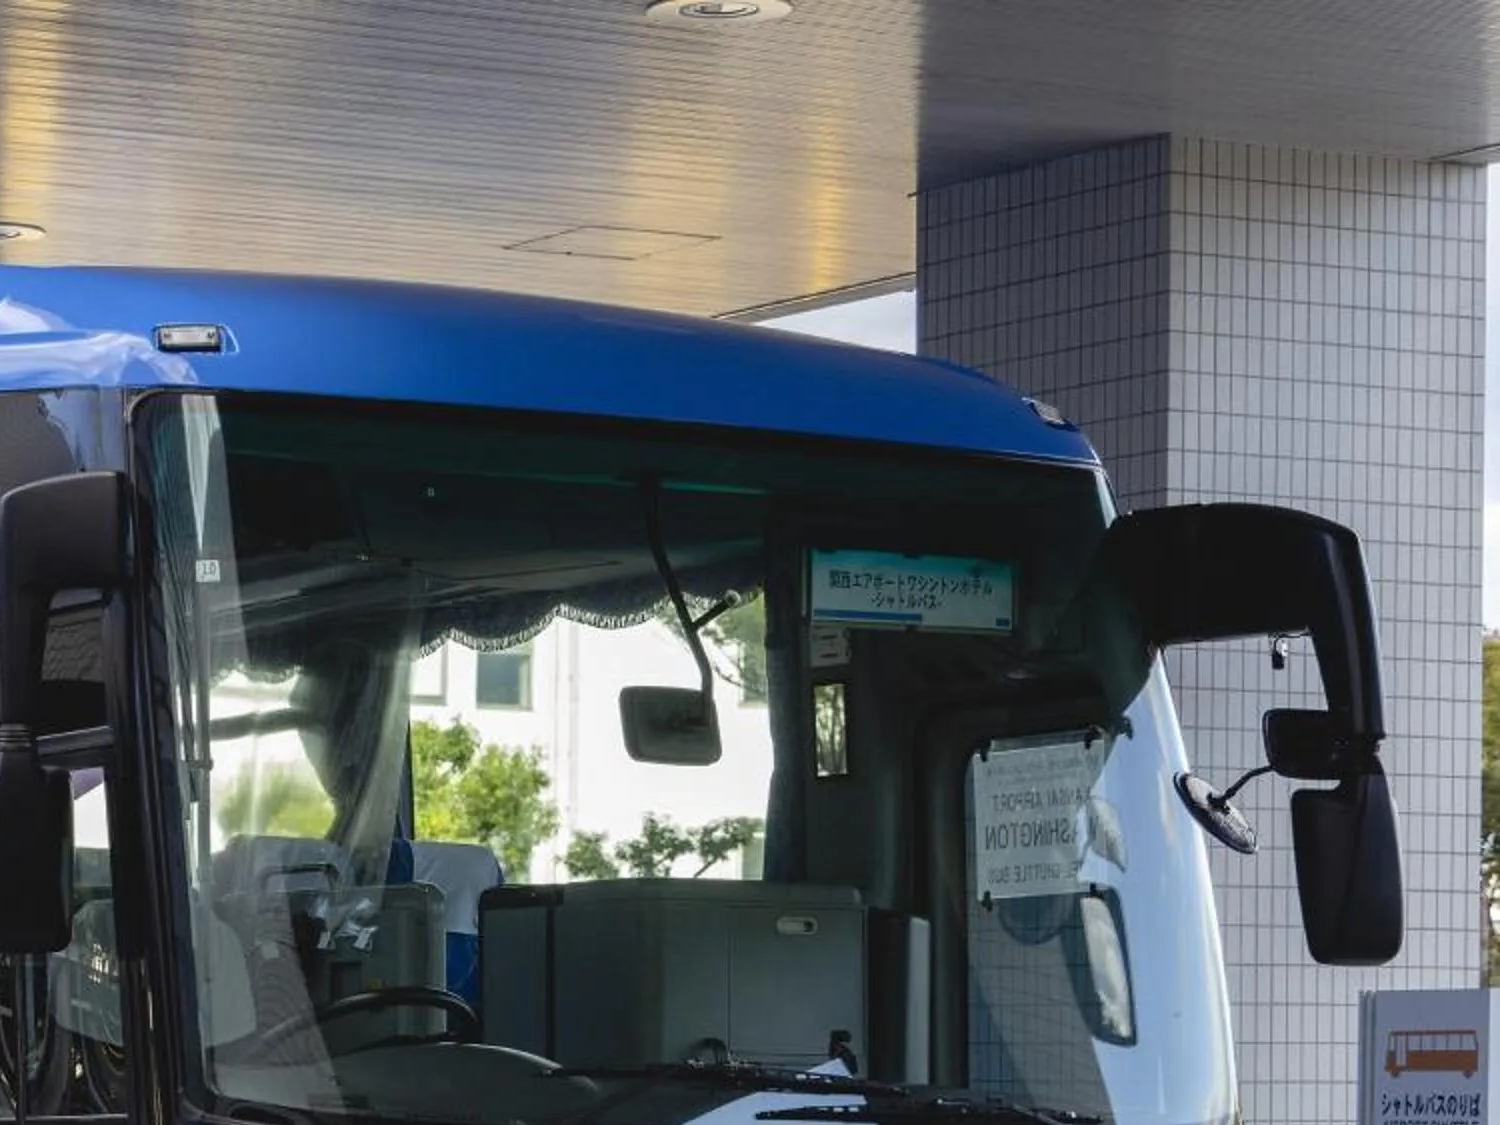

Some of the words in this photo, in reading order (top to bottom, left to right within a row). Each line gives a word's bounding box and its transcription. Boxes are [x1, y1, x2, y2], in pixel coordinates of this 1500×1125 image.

[1381, 1092, 1481, 1117] シャトルバスのりば
